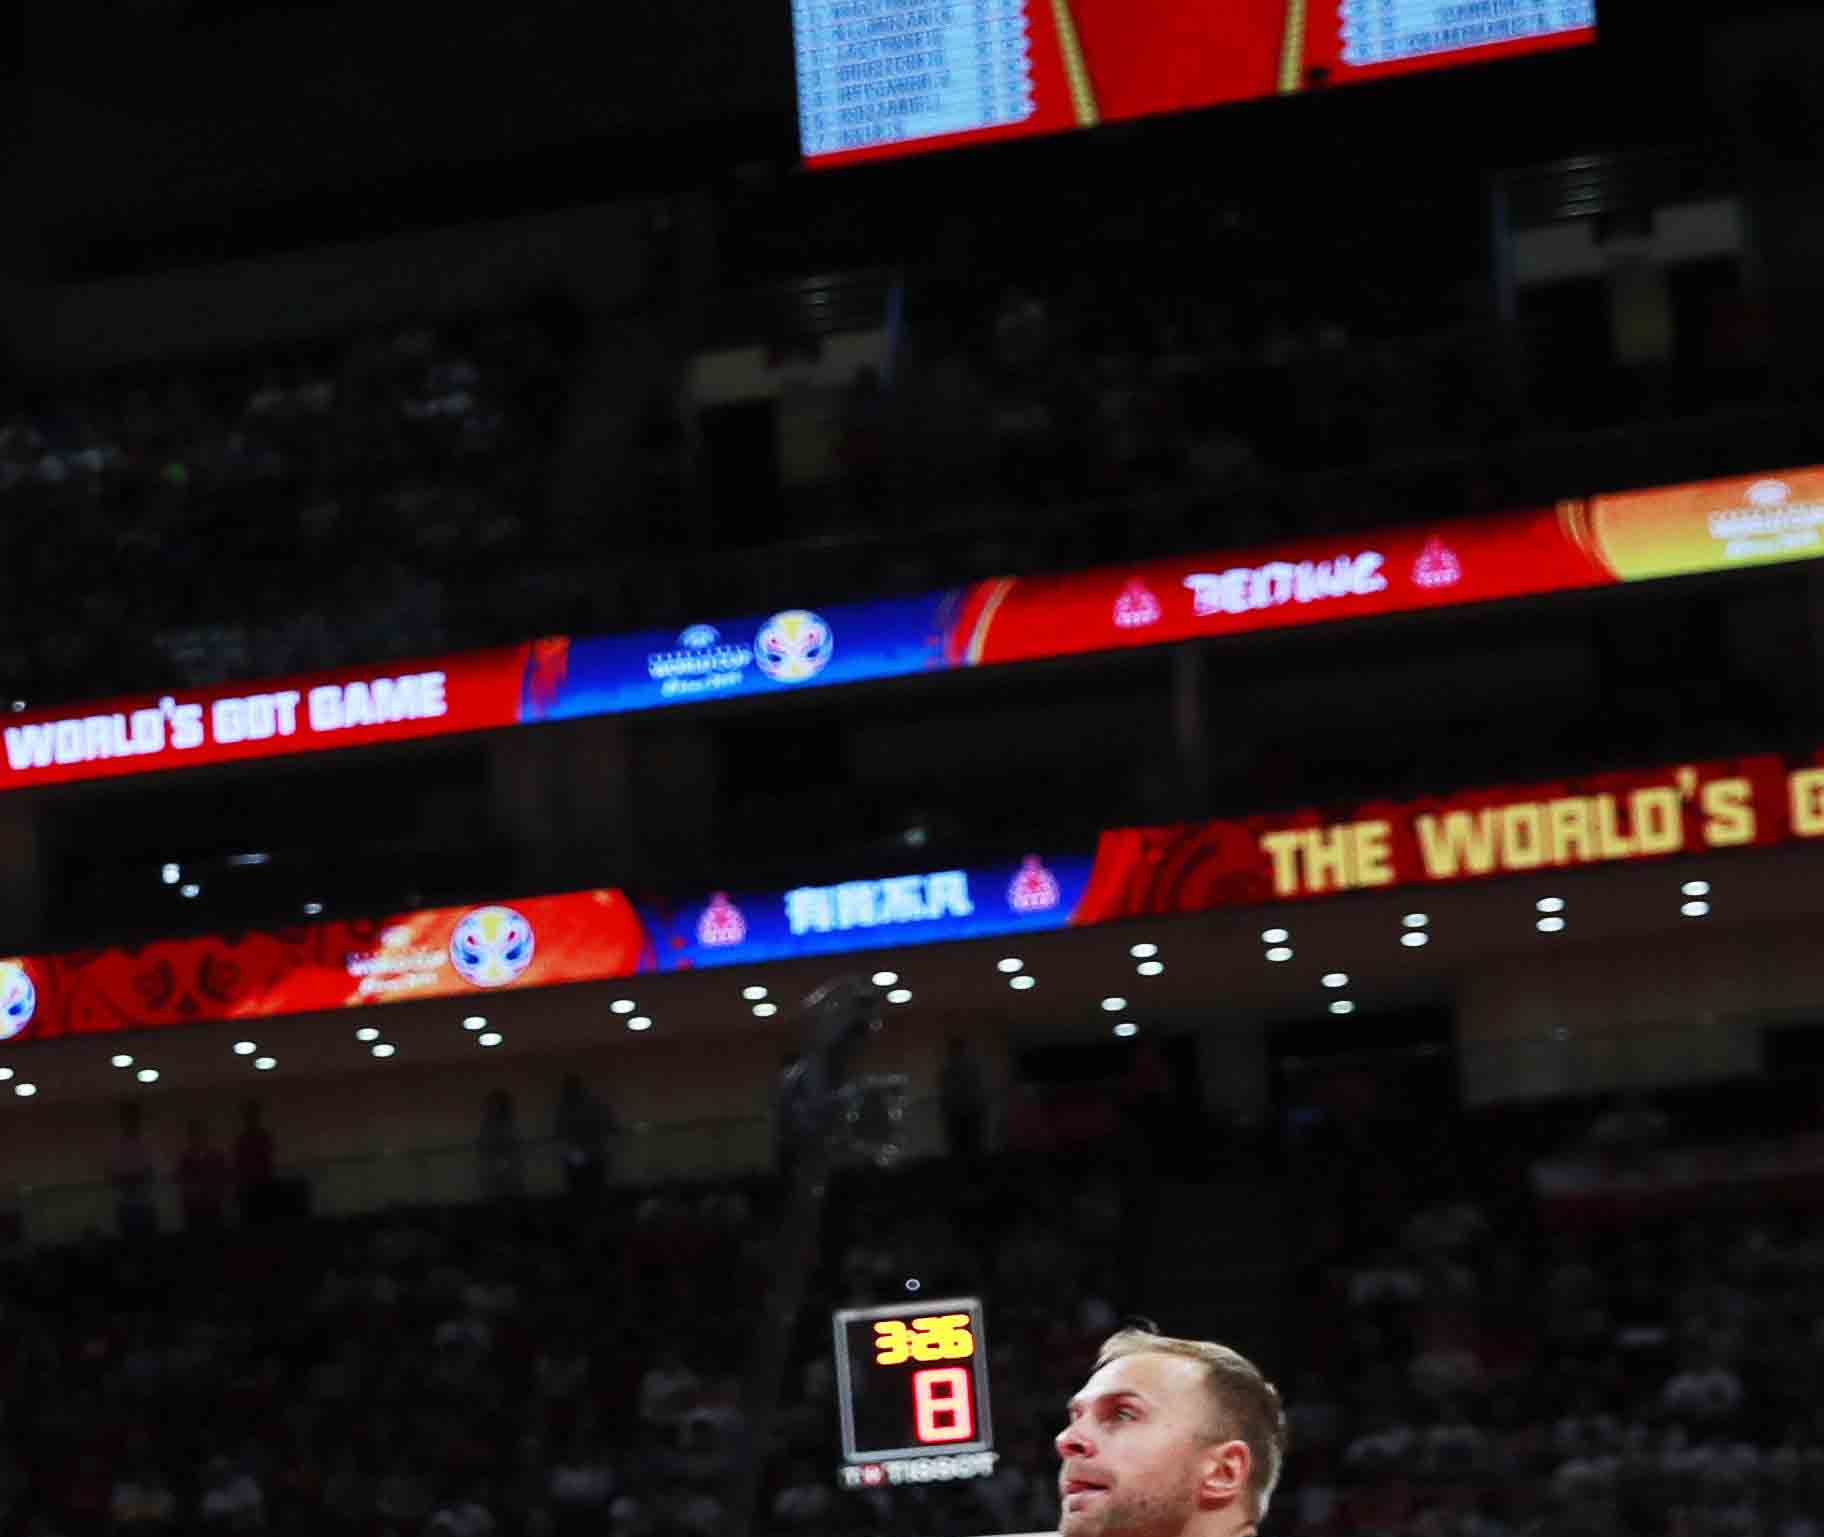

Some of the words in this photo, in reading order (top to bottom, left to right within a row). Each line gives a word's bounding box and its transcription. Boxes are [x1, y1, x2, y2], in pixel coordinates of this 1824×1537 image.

[5, 697, 204, 772] WORLD'S
[211, 689, 300, 744] GOT
[307, 670, 447, 733] GAME
[1261, 821, 1394, 896] THE
[1416, 765, 1754, 881] WORLD'S
[914, 1367, 974, 1442] 8
